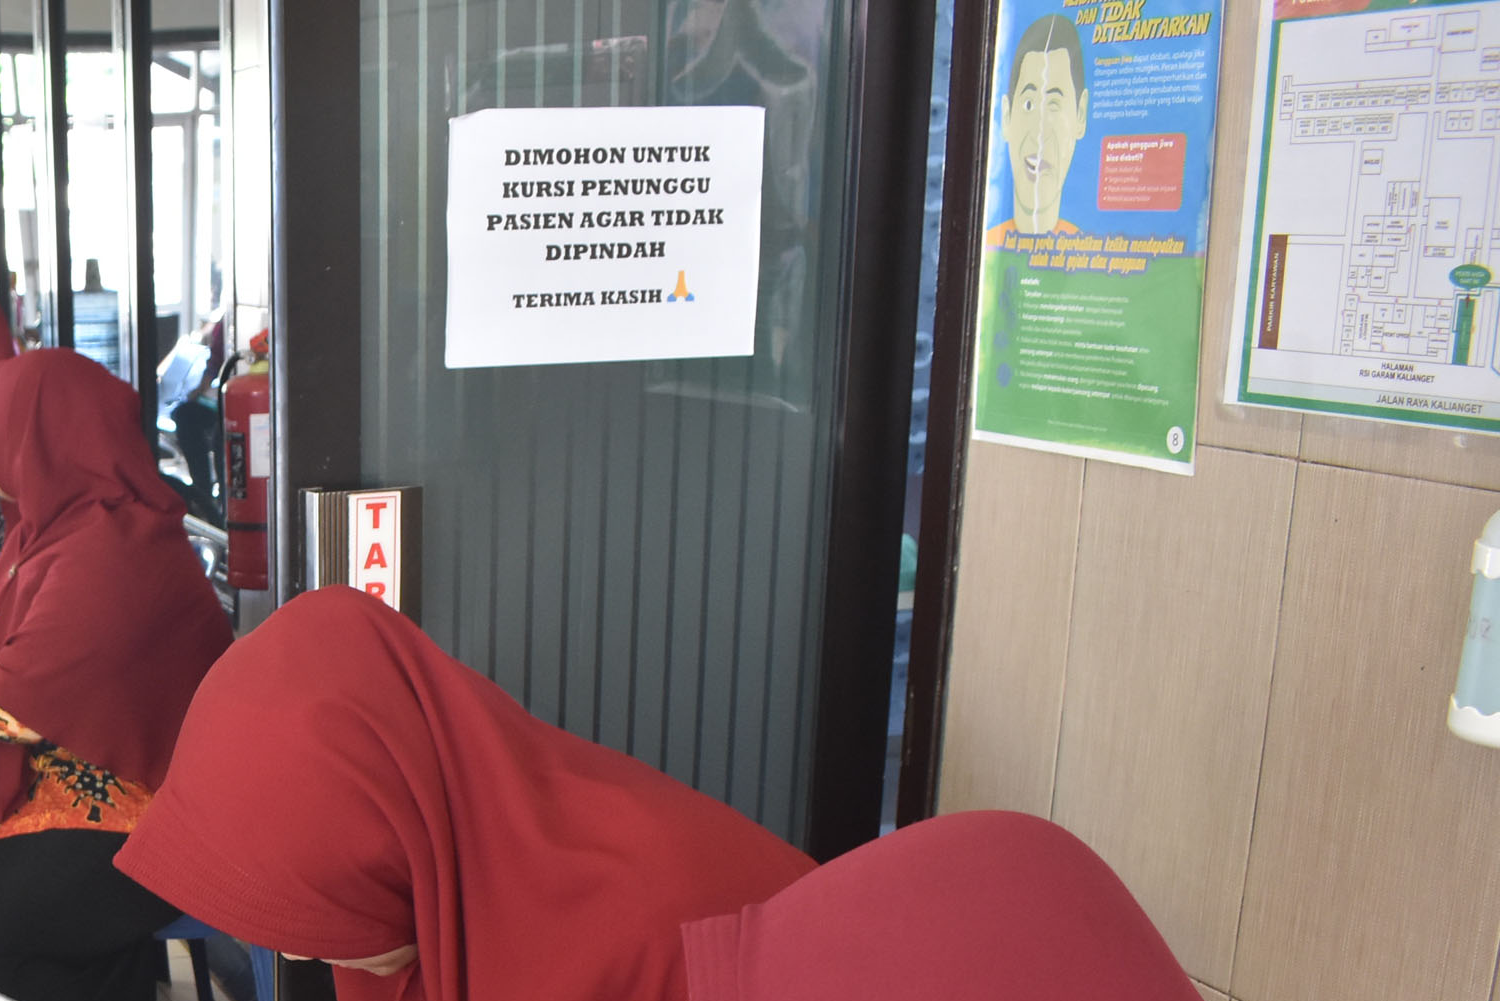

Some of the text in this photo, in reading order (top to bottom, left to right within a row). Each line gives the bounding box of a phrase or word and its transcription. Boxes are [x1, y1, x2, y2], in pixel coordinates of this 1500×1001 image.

[1076, 0, 1145, 25] DAN TIDAK
[1092, 13, 1211, 44] DITELANTARKAN
[504, 145, 710, 166] DIMOHON UNTUK
[1107, 141, 1129, 151] Apakah
[502, 177, 711, 199] KURSI PENUNGGU
[486, 208, 724, 231] PASIEN AGAR TIDAK
[545, 241, 666, 261] DIPINDAH
[512, 289, 662, 309] TERIMA KASIH
[1359, 368, 1436, 383] RSI GARAM KALIANGET
[1381, 361, 1414, 372] HALAMAN
[1376, 394, 1483, 414] JALAN RAYA KALIANGET
[1172, 433, 1179, 446] 8
